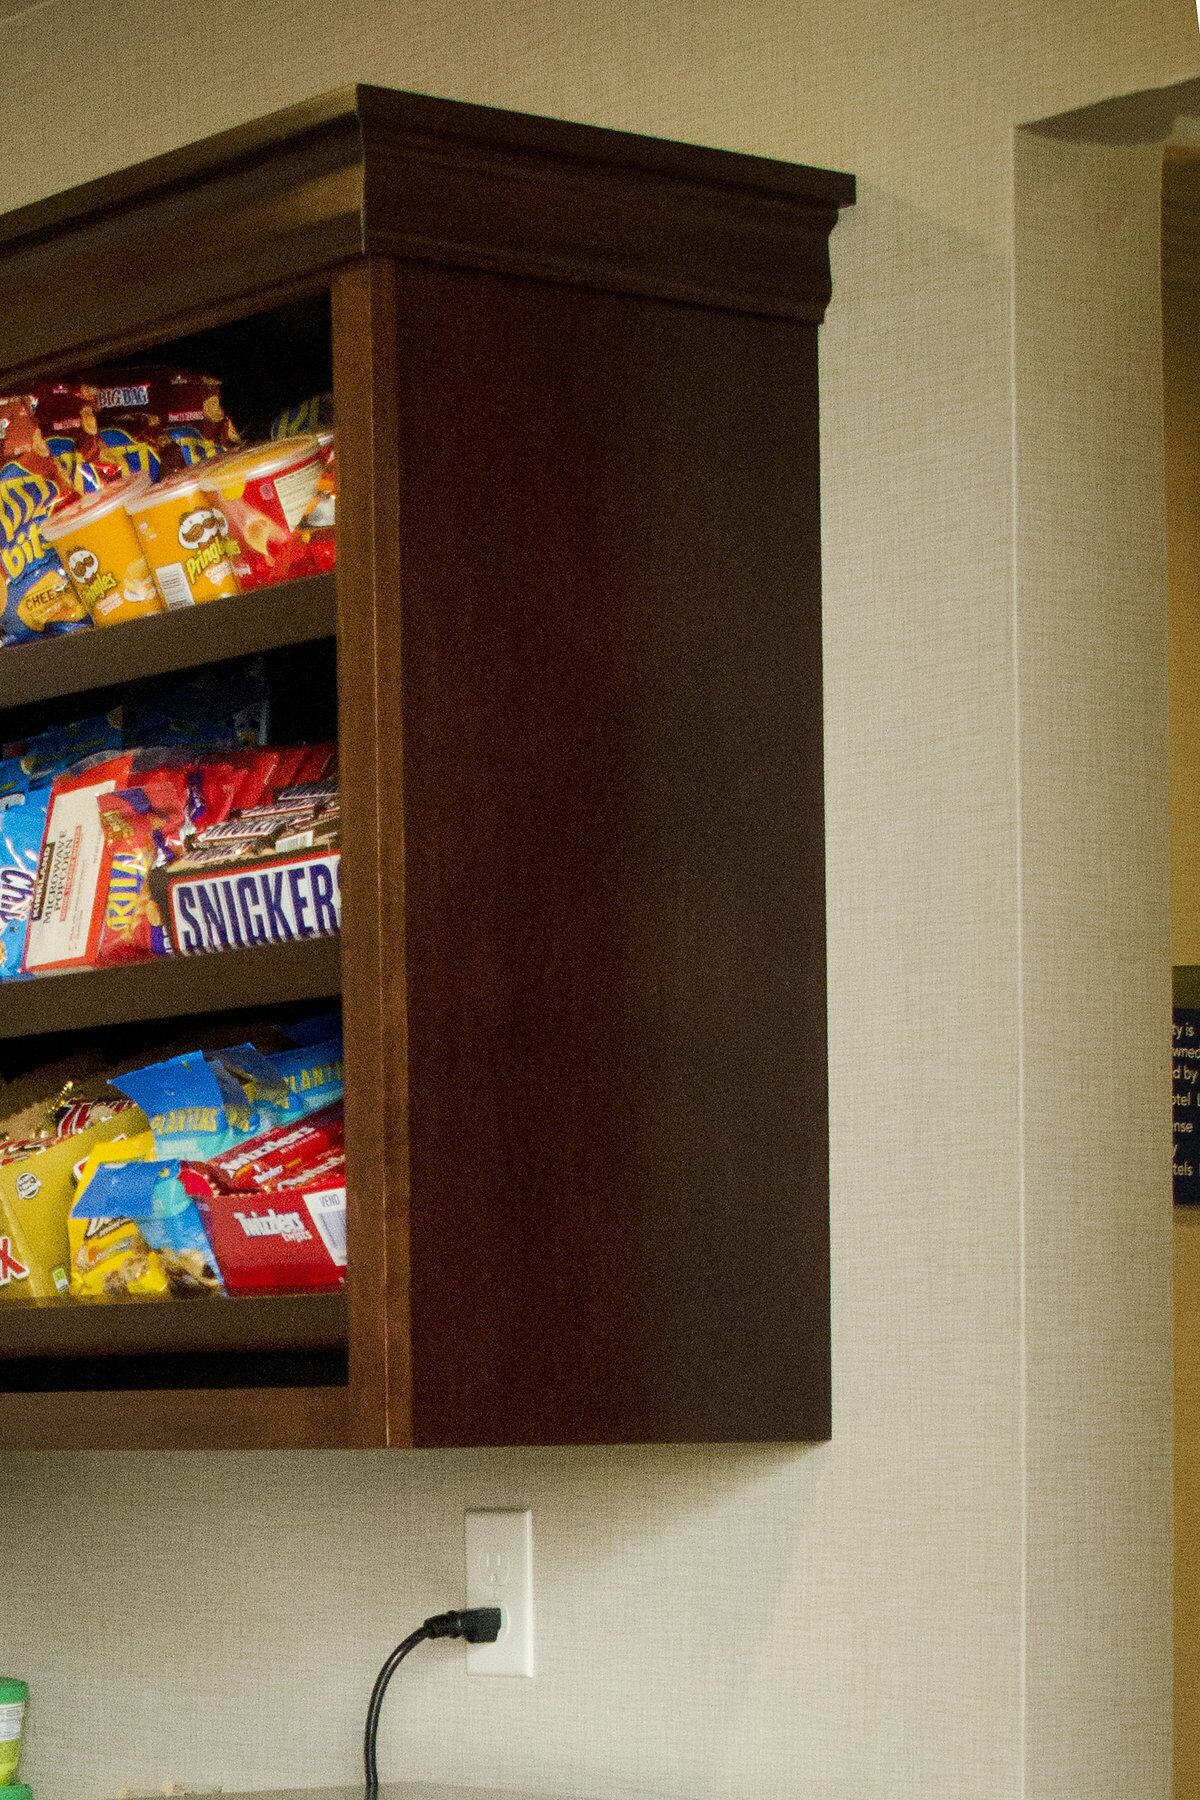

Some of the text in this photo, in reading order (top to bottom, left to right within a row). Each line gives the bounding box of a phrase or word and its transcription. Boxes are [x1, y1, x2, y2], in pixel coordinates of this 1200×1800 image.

[1, 521, 50, 580] bit
[43, 831, 66, 925] MICROWAVE
[53, 838, 74, 912] POPCORN
[177, 862, 340, 955] SNICKER
[233, 1208, 306, 1237] Twizzlers
